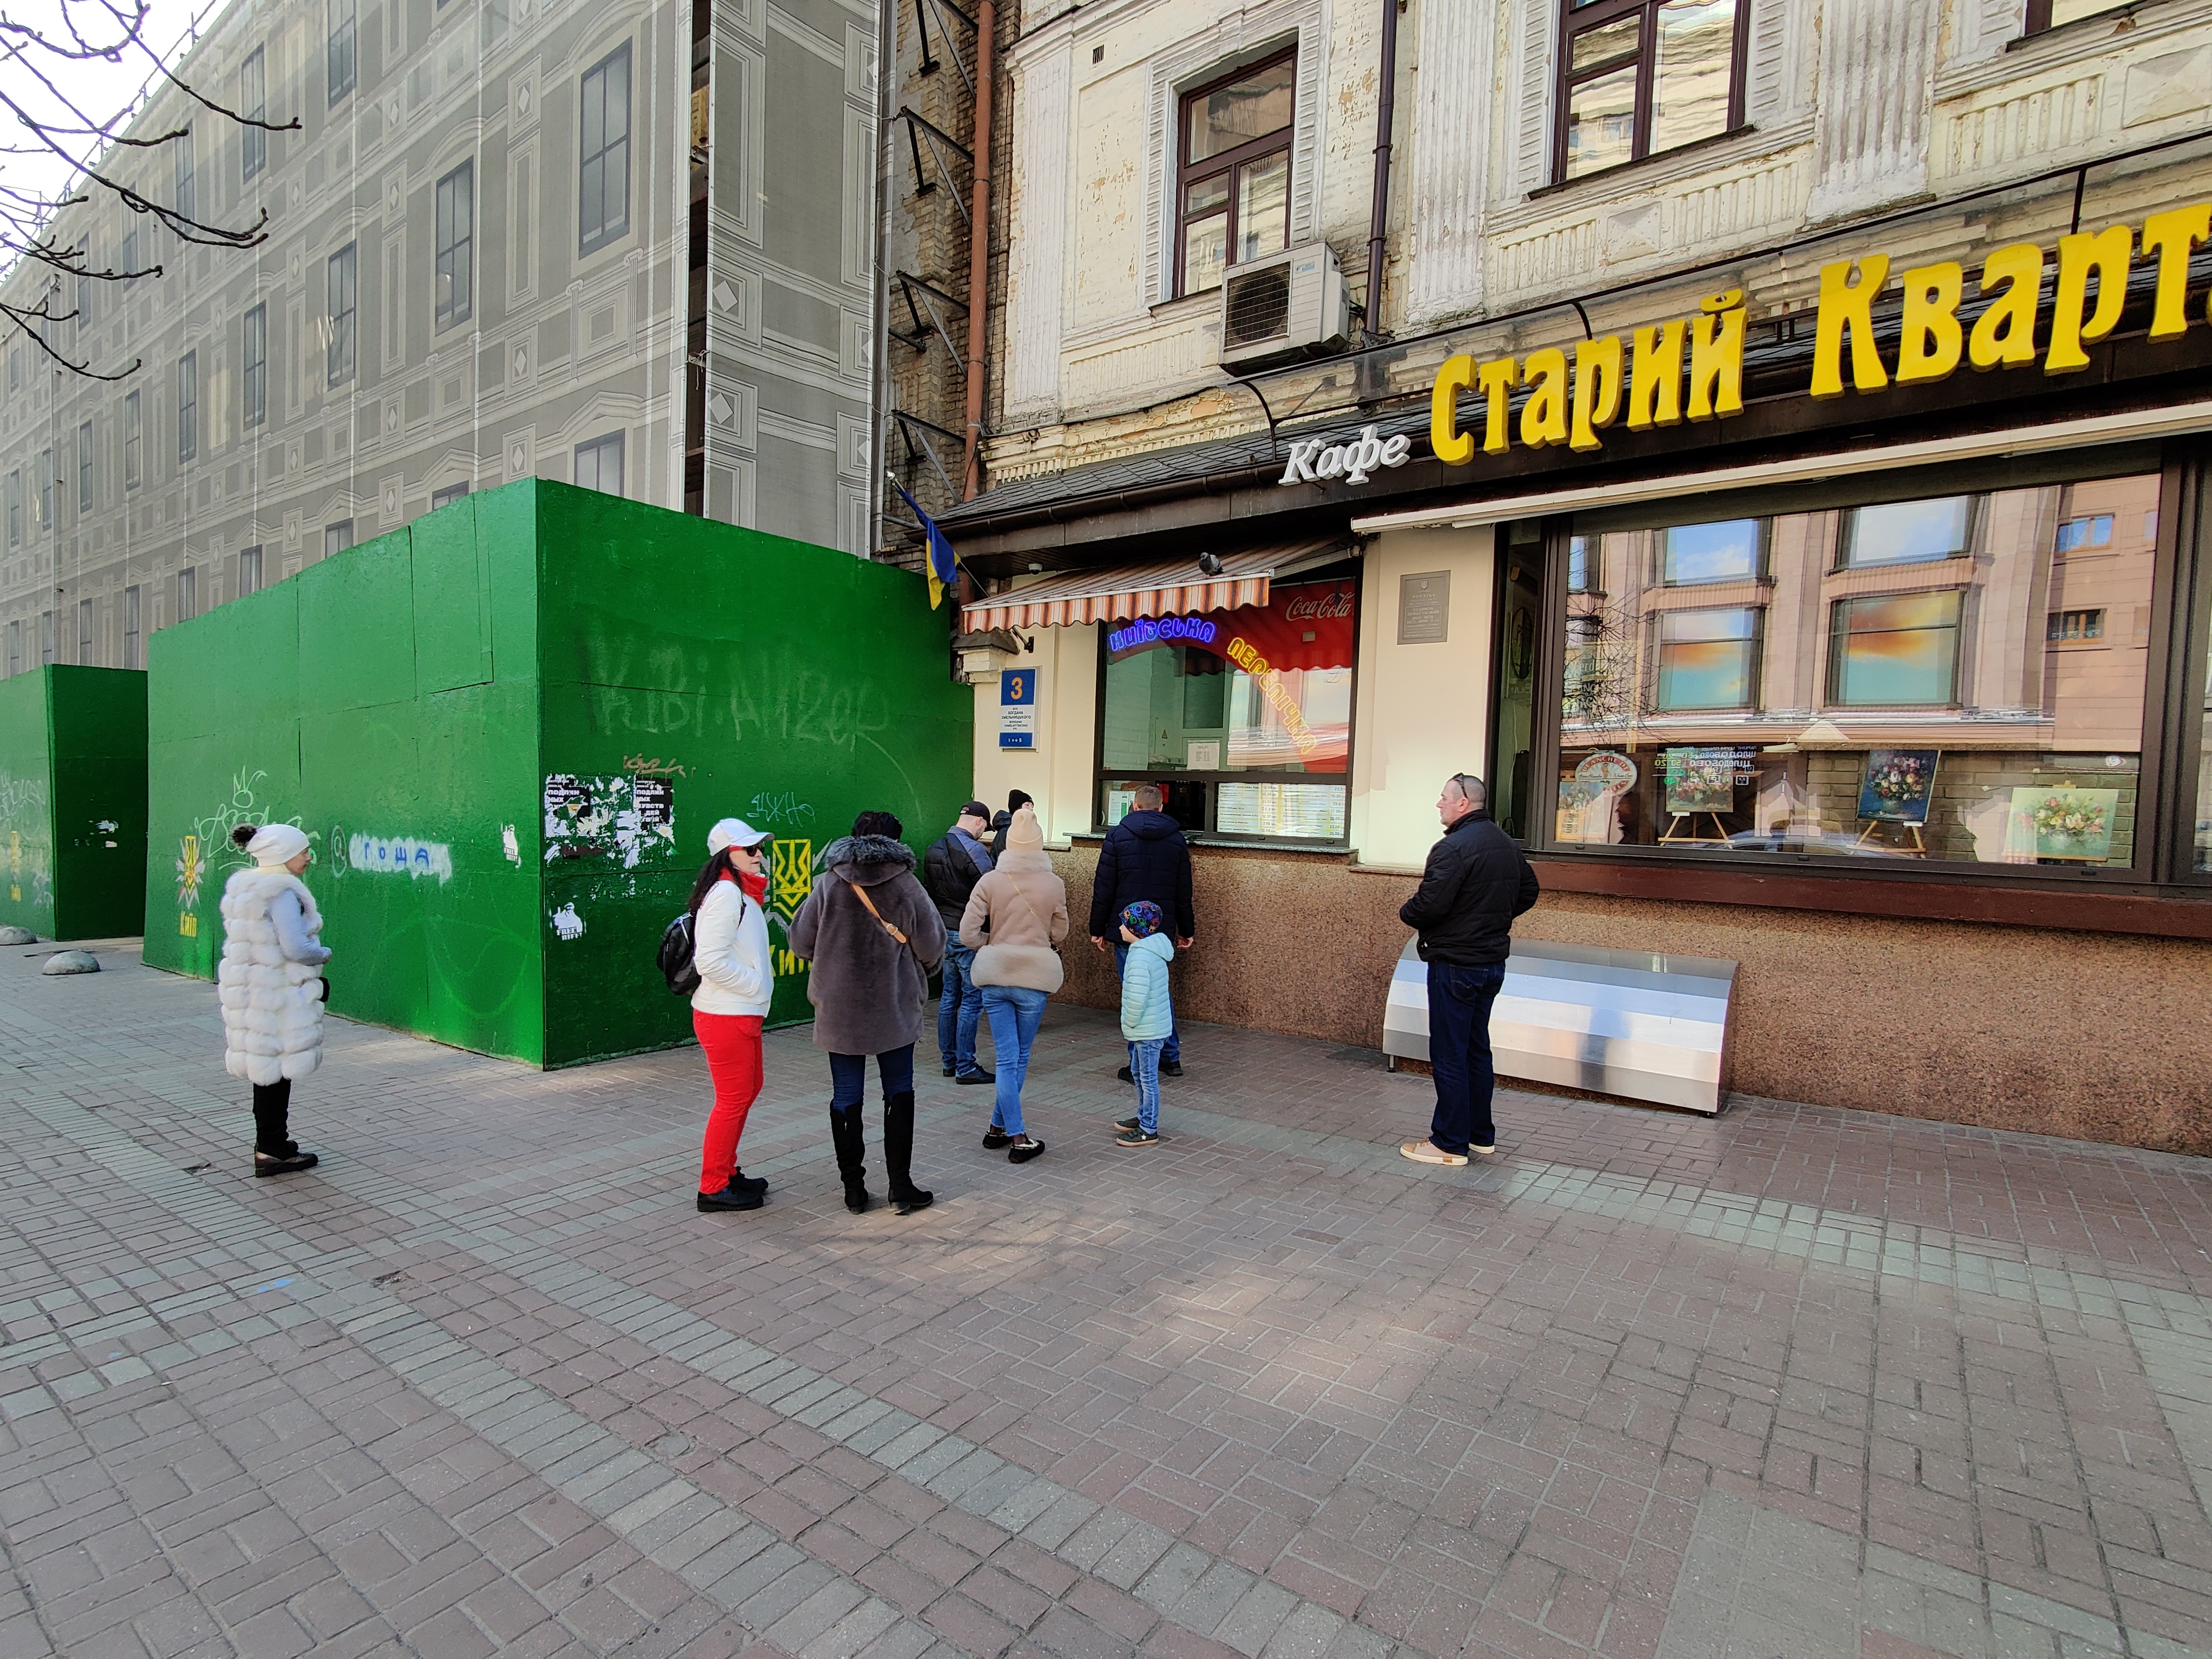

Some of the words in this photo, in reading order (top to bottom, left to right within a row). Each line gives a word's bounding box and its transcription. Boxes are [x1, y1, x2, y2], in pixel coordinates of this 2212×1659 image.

[1278, 424, 1411, 486] Кафе
[1431, 289, 1749, 467] Старий
[1810, 202, 2212, 401] Кварт
[1286, 591, 1355, 622] Coca-Cola
[1010, 677, 1022, 700] 3
[556, 927, 577, 936] FREE
